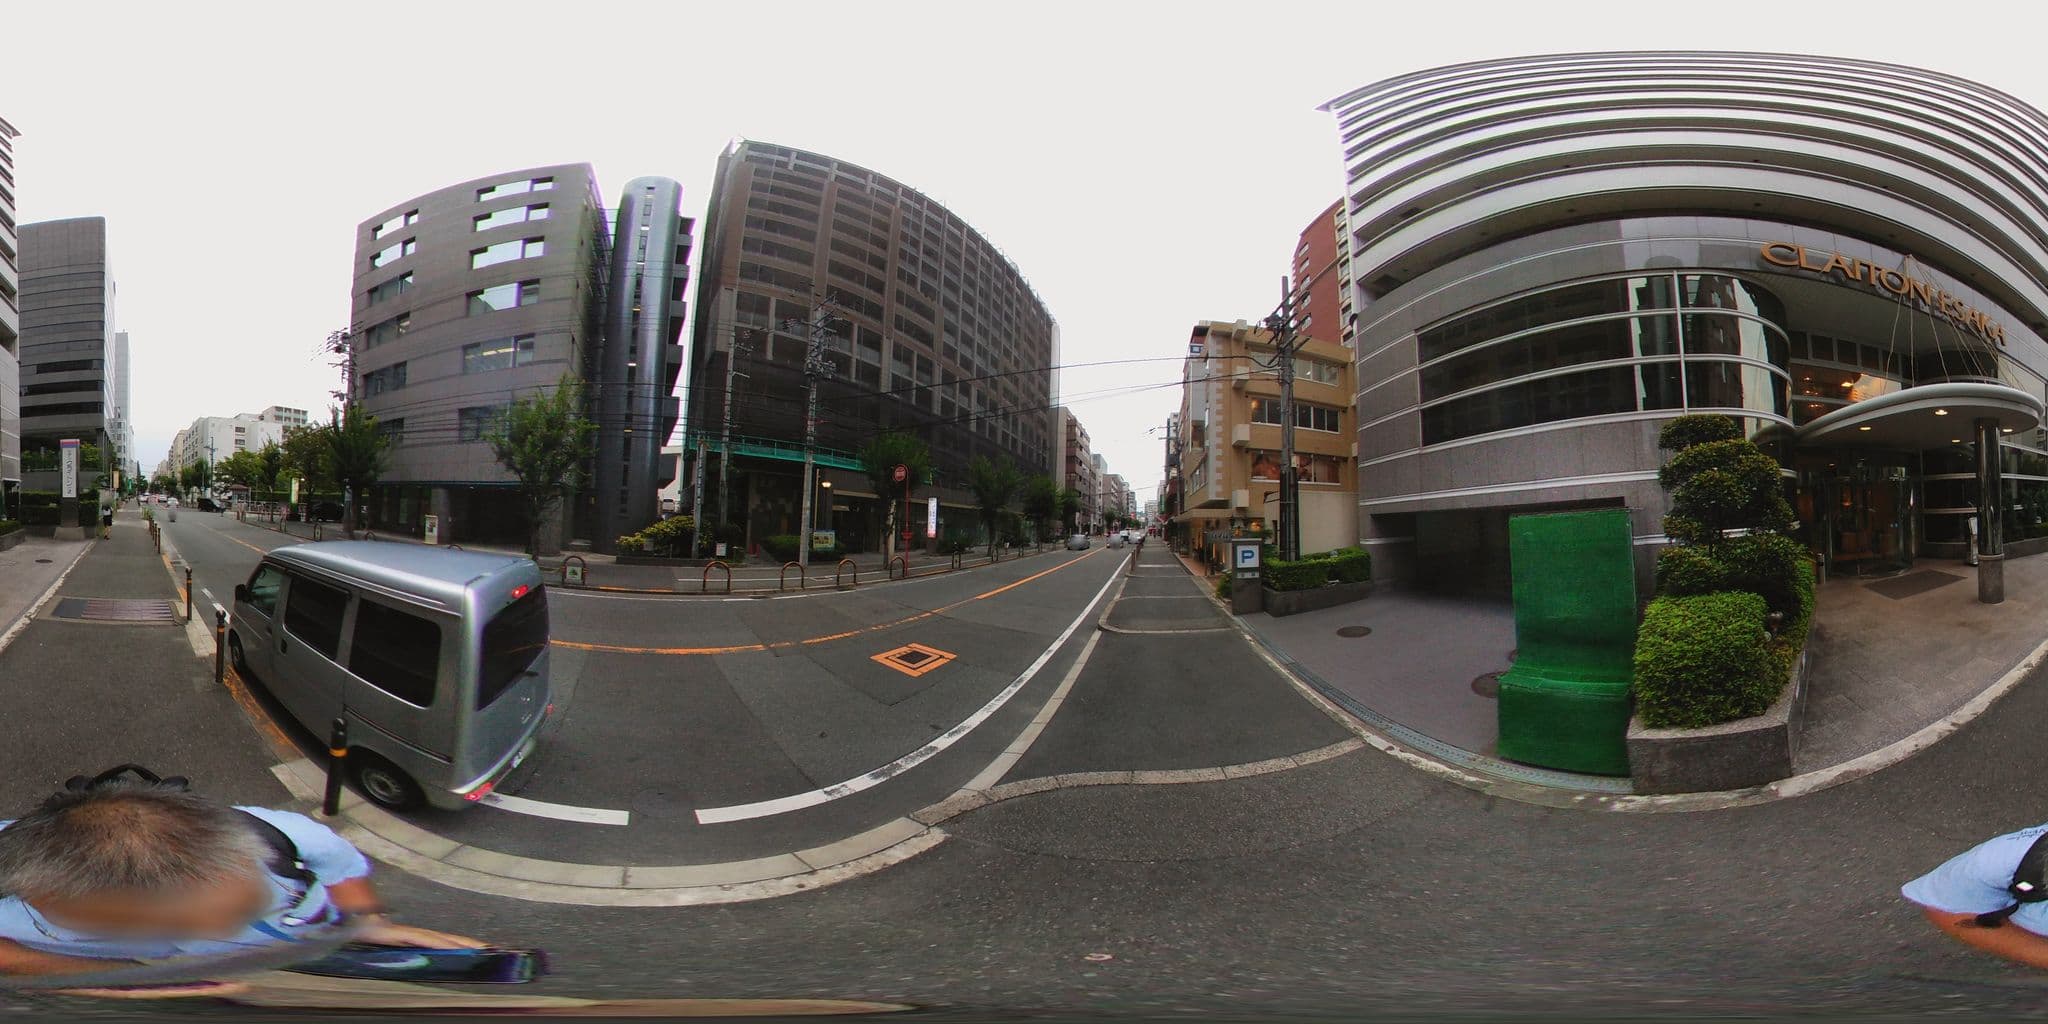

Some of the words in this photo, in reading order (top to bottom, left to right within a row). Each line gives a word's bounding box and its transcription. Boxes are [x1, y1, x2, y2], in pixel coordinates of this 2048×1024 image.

[1760, 242, 1932, 306] CLAITON
[1937, 290, 2006, 346] ESAKA
[1241, 549, 1255, 564] P
